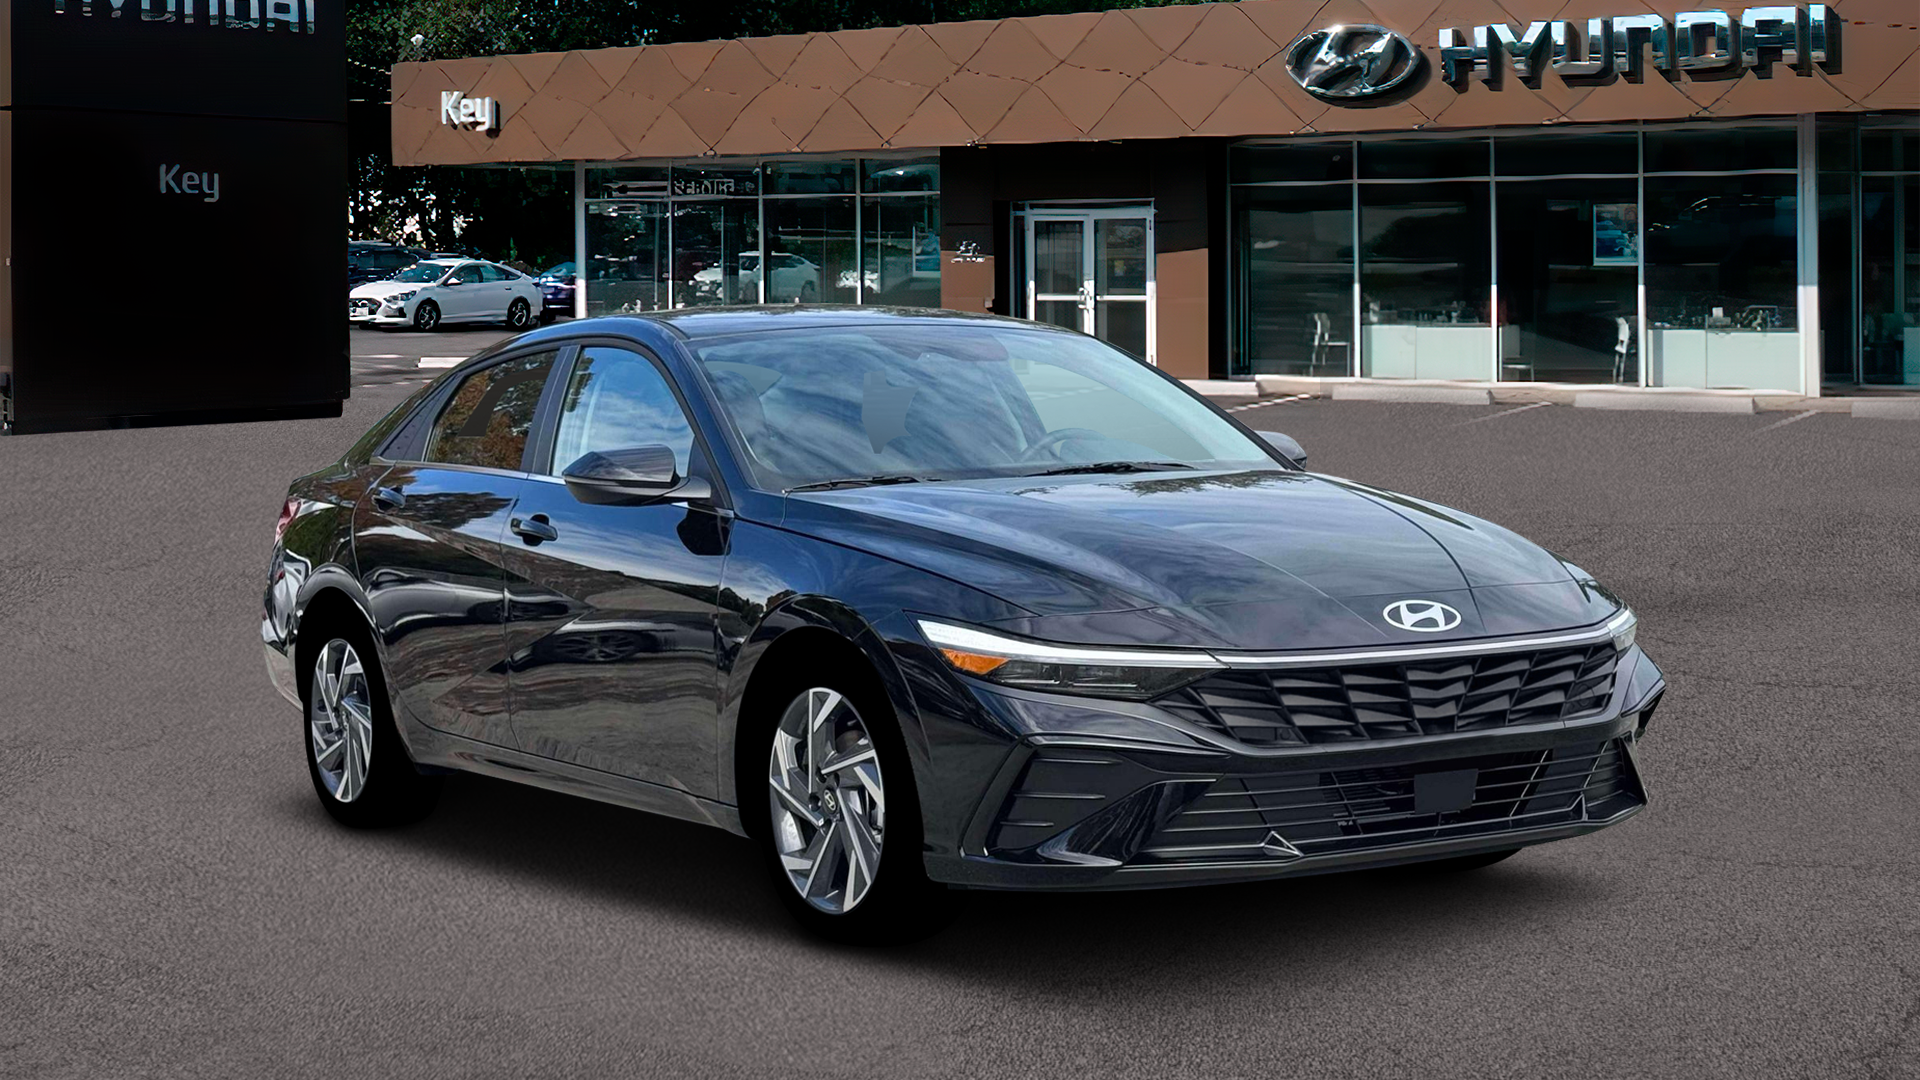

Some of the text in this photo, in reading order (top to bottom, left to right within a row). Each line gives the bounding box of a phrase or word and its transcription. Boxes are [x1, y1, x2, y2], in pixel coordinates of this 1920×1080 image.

[1439, 4, 1841, 89] HYUNDAI
[441, 90, 494, 133] Key
[159, 163, 220, 203] Key
